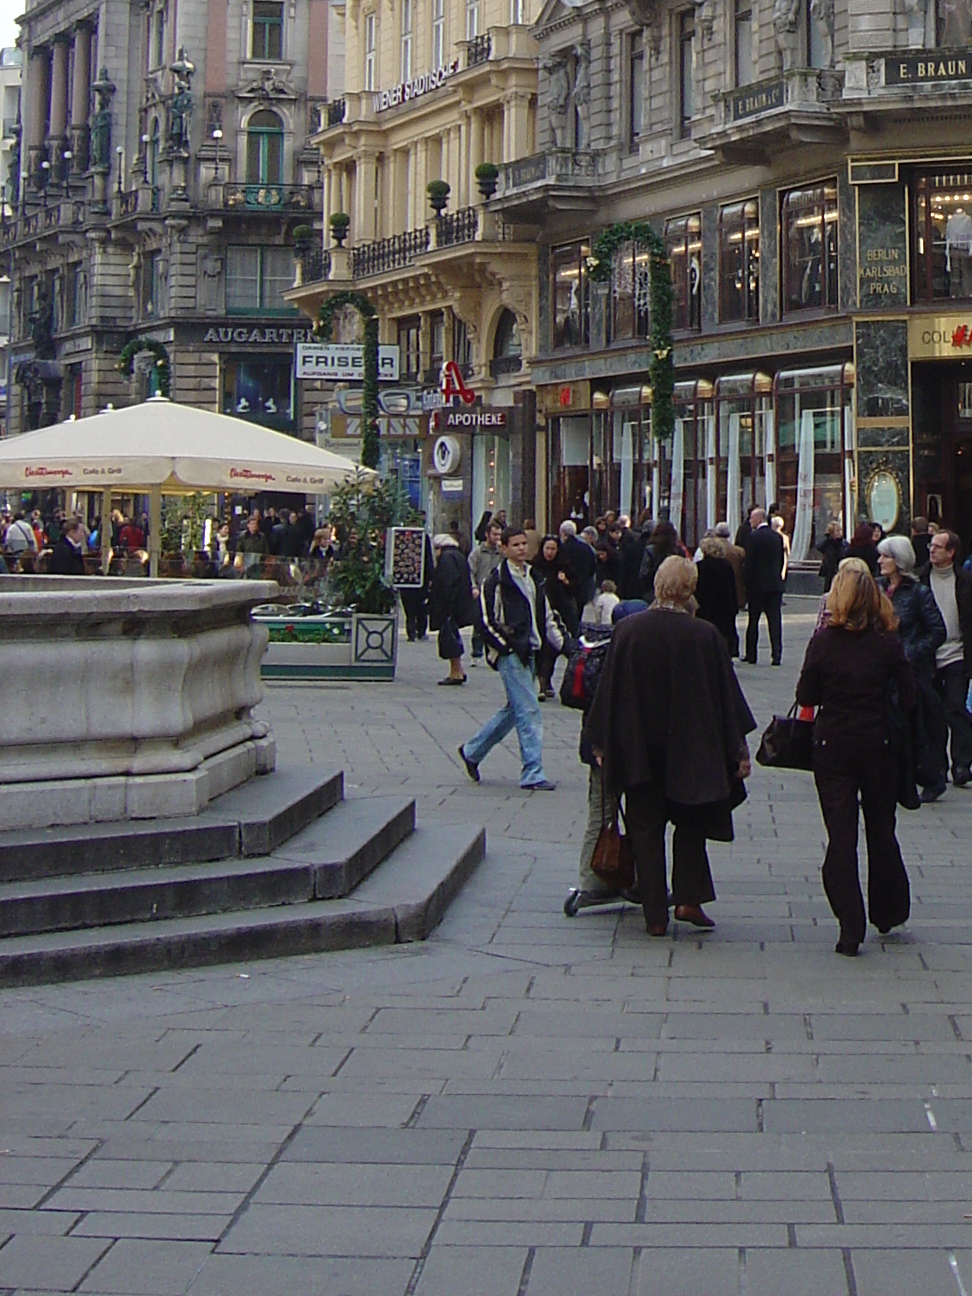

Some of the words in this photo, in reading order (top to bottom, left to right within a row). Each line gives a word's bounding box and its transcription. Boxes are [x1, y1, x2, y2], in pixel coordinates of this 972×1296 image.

[917, 60, 966, 77] BRAUN
[867, 248, 898, 261] BERLIN
[859, 265, 907, 278] KARLSBAD
[870, 282, 898, 294] PRAG
[203, 328, 319, 343] AUGARTEN
[302, 355, 394, 368] FRISER
[346, 417, 420, 435] ZISS
[447, 413, 505, 426] APOTHEKE
